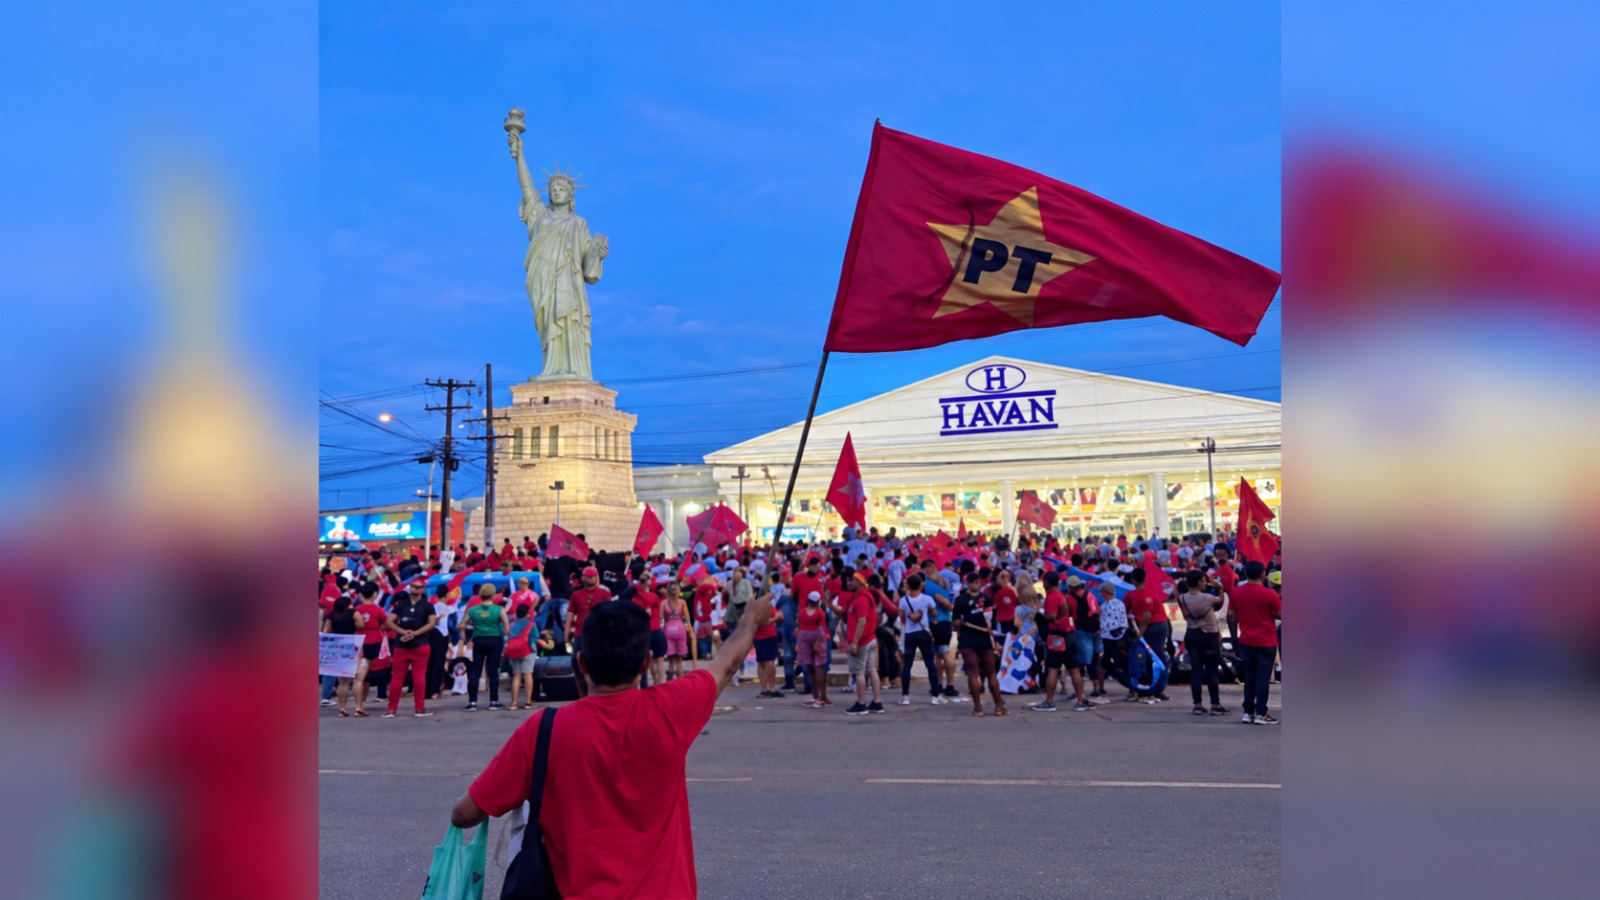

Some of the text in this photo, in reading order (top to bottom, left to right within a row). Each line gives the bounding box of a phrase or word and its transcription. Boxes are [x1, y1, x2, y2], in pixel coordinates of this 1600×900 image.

[962, 237, 1053, 294] PT
[983, 367, 1007, 390] H
[940, 397, 1055, 429] HAVAN
